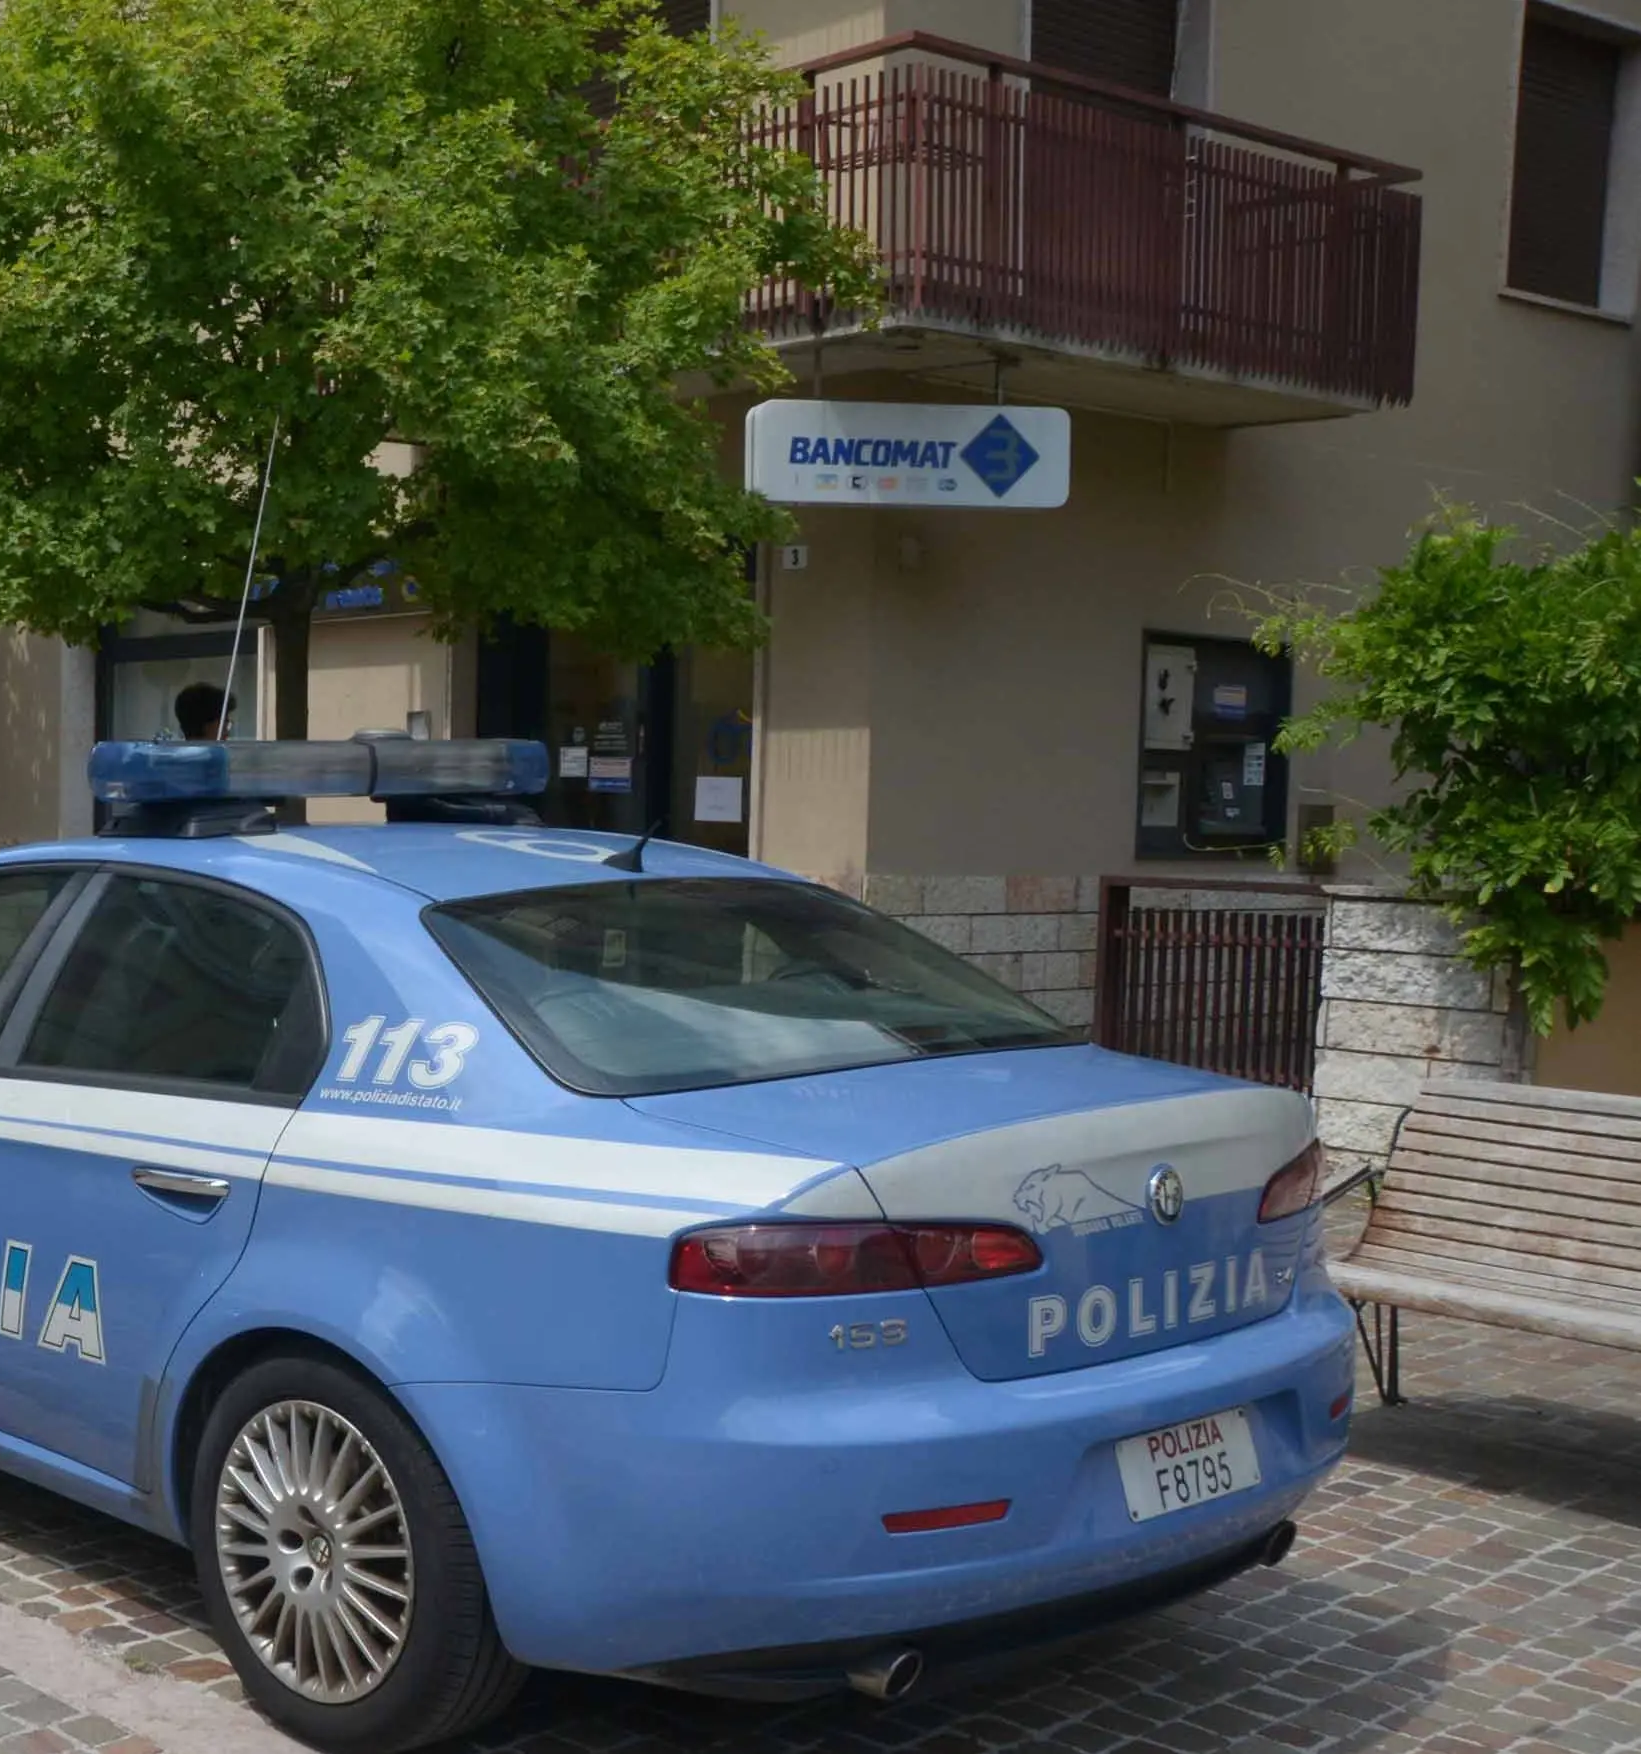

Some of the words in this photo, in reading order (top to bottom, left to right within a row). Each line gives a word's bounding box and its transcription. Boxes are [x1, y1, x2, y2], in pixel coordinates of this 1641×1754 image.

[789, 436, 959, 469] BANCOMAT
[335, 1014, 480, 1091] 113
[319, 1086, 465, 1112] www.poliziadistato.it
[1027, 1247, 1269, 1359] POLIZIA
[1147, 1419, 1224, 1464] POLIZIA
[1155, 1451, 1233, 1510] F8795
